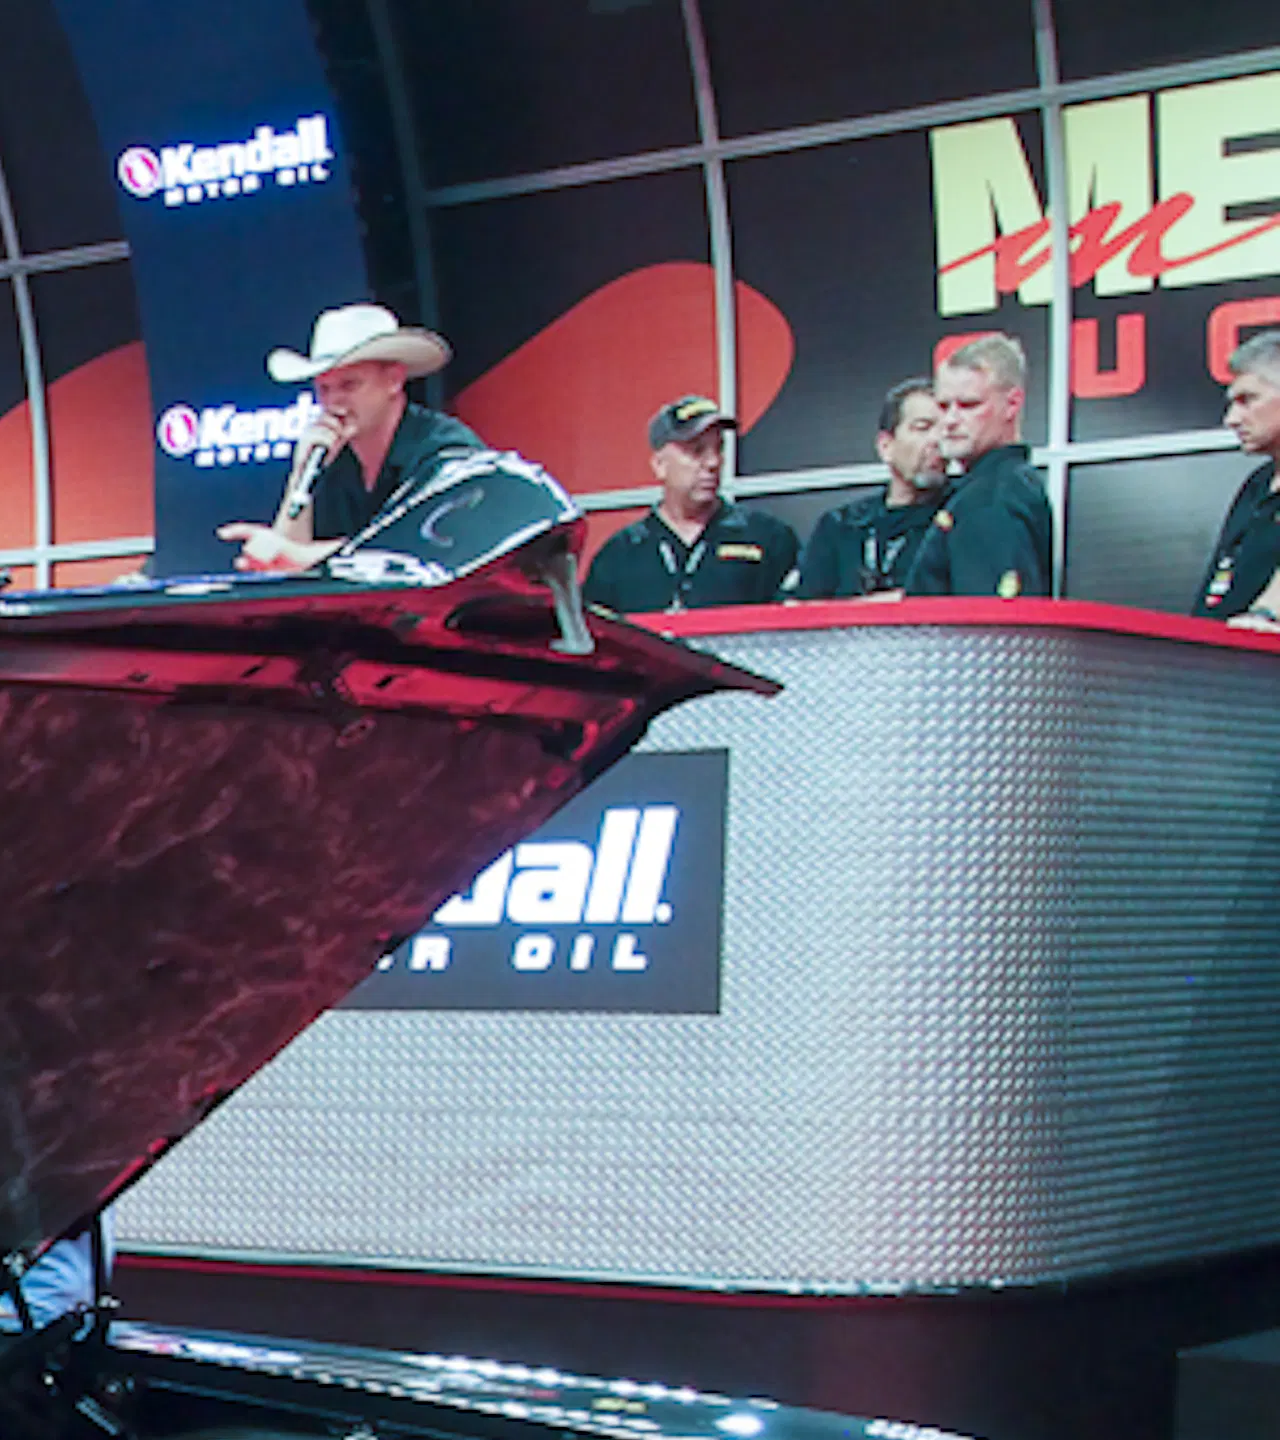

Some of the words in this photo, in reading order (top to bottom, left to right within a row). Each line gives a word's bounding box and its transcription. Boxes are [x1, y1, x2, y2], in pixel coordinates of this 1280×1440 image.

[160, 112, 334, 190] Kendall
[164, 174, 262, 207] MOTOR
[276, 164, 331, 186] OIL
[199, 389, 324, 448] Kend
[512, 932, 648, 972] OIL
